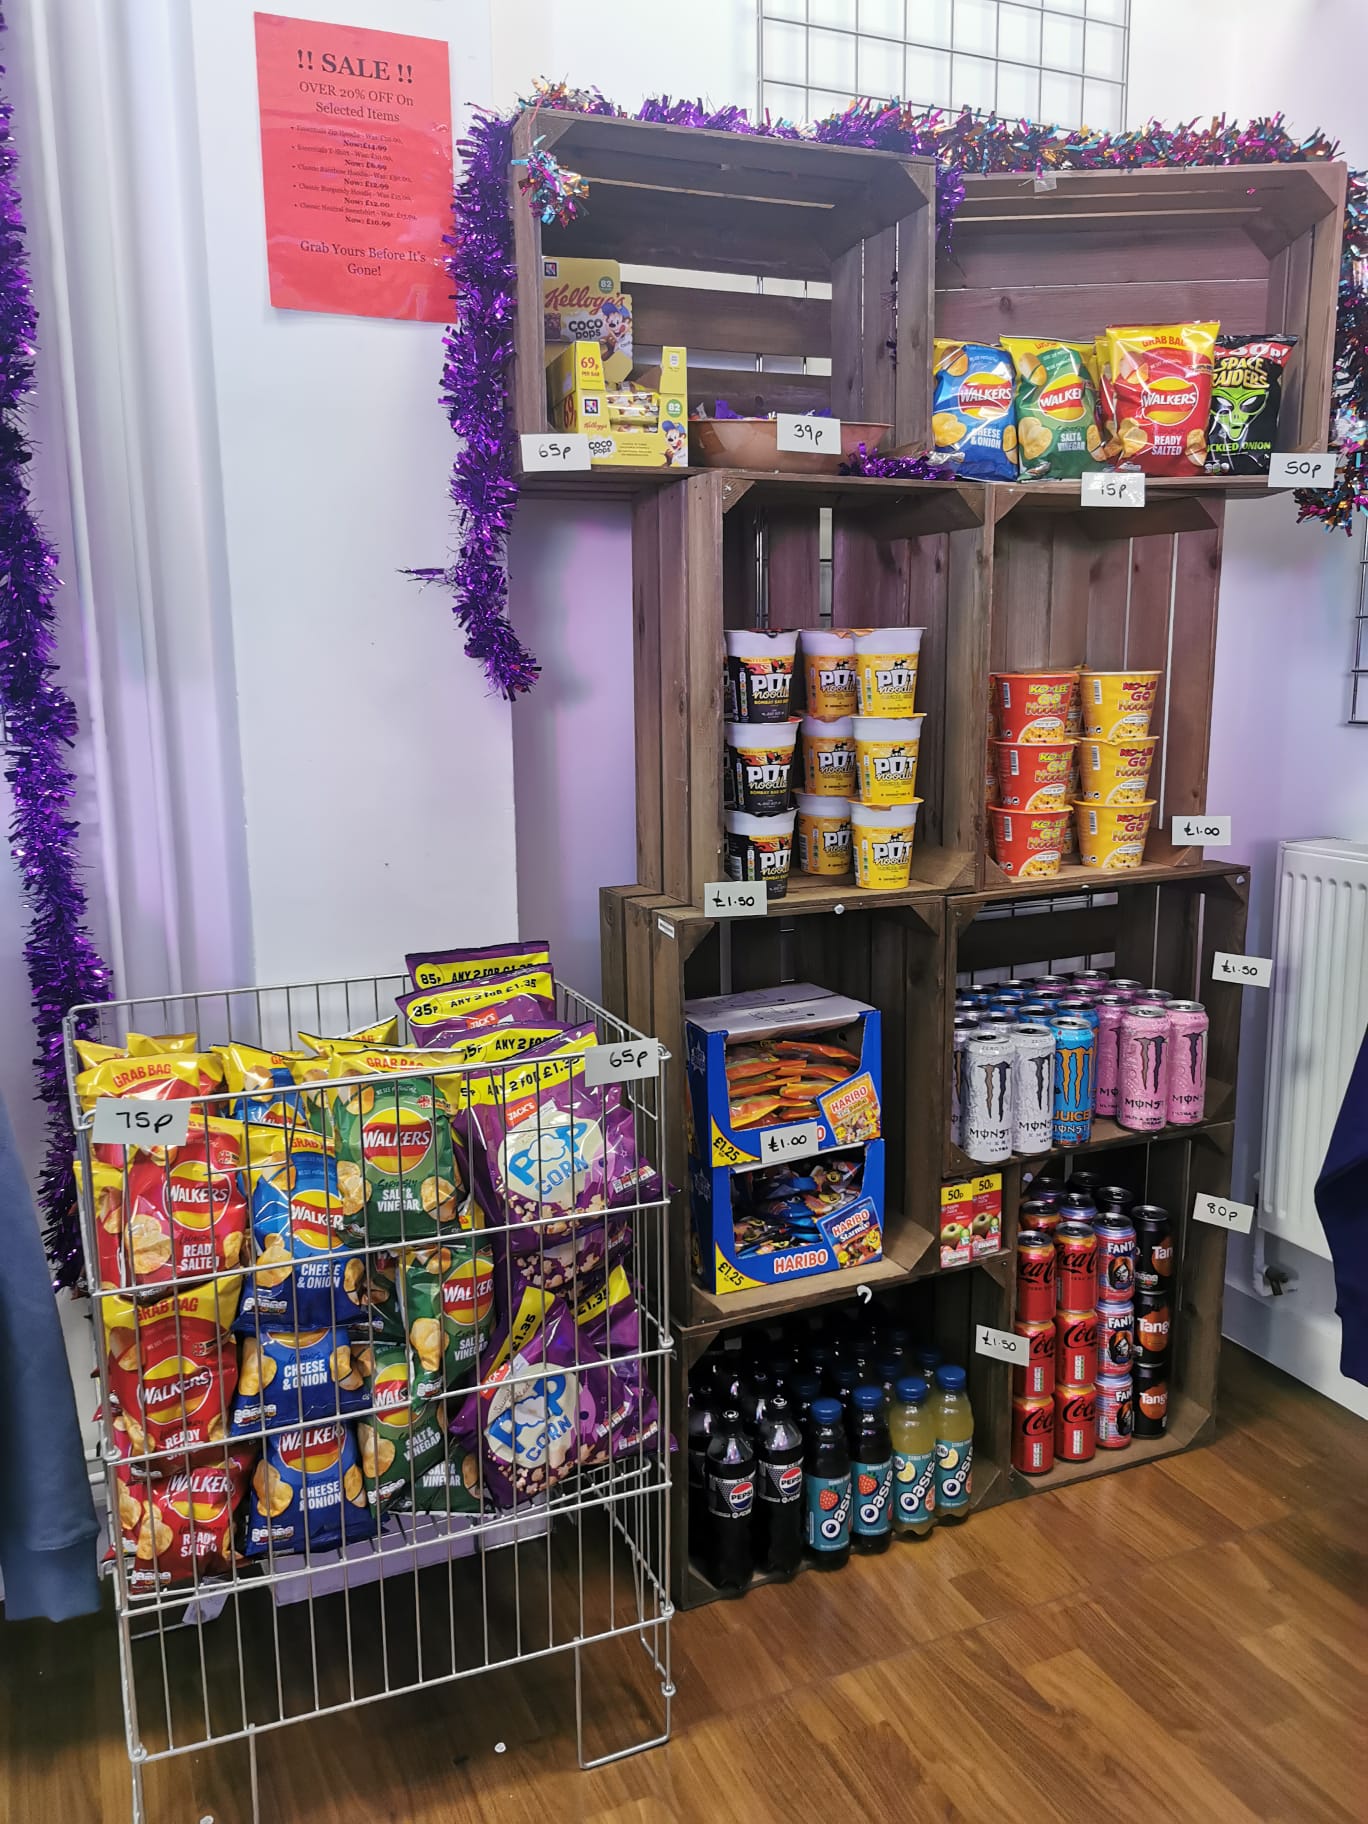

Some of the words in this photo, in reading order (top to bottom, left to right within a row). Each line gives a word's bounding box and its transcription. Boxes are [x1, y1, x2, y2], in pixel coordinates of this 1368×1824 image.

[321, 53, 390, 80] SALE
[299, 81, 337, 96] OVER
[340, 88, 366, 100] 20%
[368, 91, 394, 103] OFF
[396, 94, 414, 106] On
[315, 101, 364, 118] Selected
[367, 108, 401, 122] Items
[344, 159, 364, 168] Now:
[344, 177, 363, 187] Now:
[344, 196, 364, 206] Now:
[345, 215, 364, 225] Now:
[300, 240, 330, 254] Grab
[331, 243, 366, 258] Yours
[368, 247, 405, 261] Before
[407, 250, 426, 263] It's
[347, 262, 381, 277] Gone!
[1220, 357, 1264, 376] SPACE
[960, 387, 1012, 403] WALKERS
[1142, 391, 1197, 408] WALKERS
[667, 402, 681, 412] 82
[793, 423, 823, 445] 39p
[977, 436, 1001, 449] ONION
[1060, 432, 1075, 442] SALT
[1154, 435, 1183, 446] READY
[538, 443, 572, 459] 65p
[1057, 441, 1086, 451] VINEGAR
[1152, 445, 1183, 456] SALTED
[1242, 441, 1271, 450] ONION
[1284, 461, 1322, 478] 50p
[750, 673, 793, 692] POT
[875, 669, 917, 688] POT
[1130, 691, 1151, 702] GO
[873, 756, 917, 774] POT
[1127, 756, 1147, 768] GO
[746, 764, 791, 783] POT
[1125, 822, 1145, 833] GO
[1183, 821, 1221, 837] £1.00
[872, 841, 913, 859] POT
[712, 889, 755, 907] £1.50
[1222, 959, 1258, 976] £1.50
[420, 972, 442, 985] 85p
[452, 970, 473, 983] ANY
[473, 969, 483, 981] 2
[450, 996, 471, 1008] ANY
[495, 1038, 515, 1051] ANY
[517, 1038, 526, 1049] 2
[366, 1057, 398, 1068] GRAB
[609, 1050, 649, 1069] 65p
[113, 1066, 147, 1089] GRAB
[147, 1063, 172, 1077] BAG
[511, 1081, 519, 1092] 2
[831, 1086, 867, 1113] HARIBO
[507, 1101, 536, 1121] JACK'S
[115, 1111, 174, 1134] 75p
[363, 1129, 431, 1148] WALKERS
[768, 1134, 807, 1152] £1.00
[713, 1136, 740, 1161] £1.25
[534, 1153, 589, 1195] CORN
[978, 1178, 994, 1191] 50p
[948, 1189, 964, 1201] 50p
[832, 1208, 870, 1238] HARIBO
[774, 1249, 829, 1275] HARIBO
[717, 1261, 745, 1287] £1.25
[981, 1331, 1017, 1351] £1.50
[900, 1460, 936, 1513] Oasis
